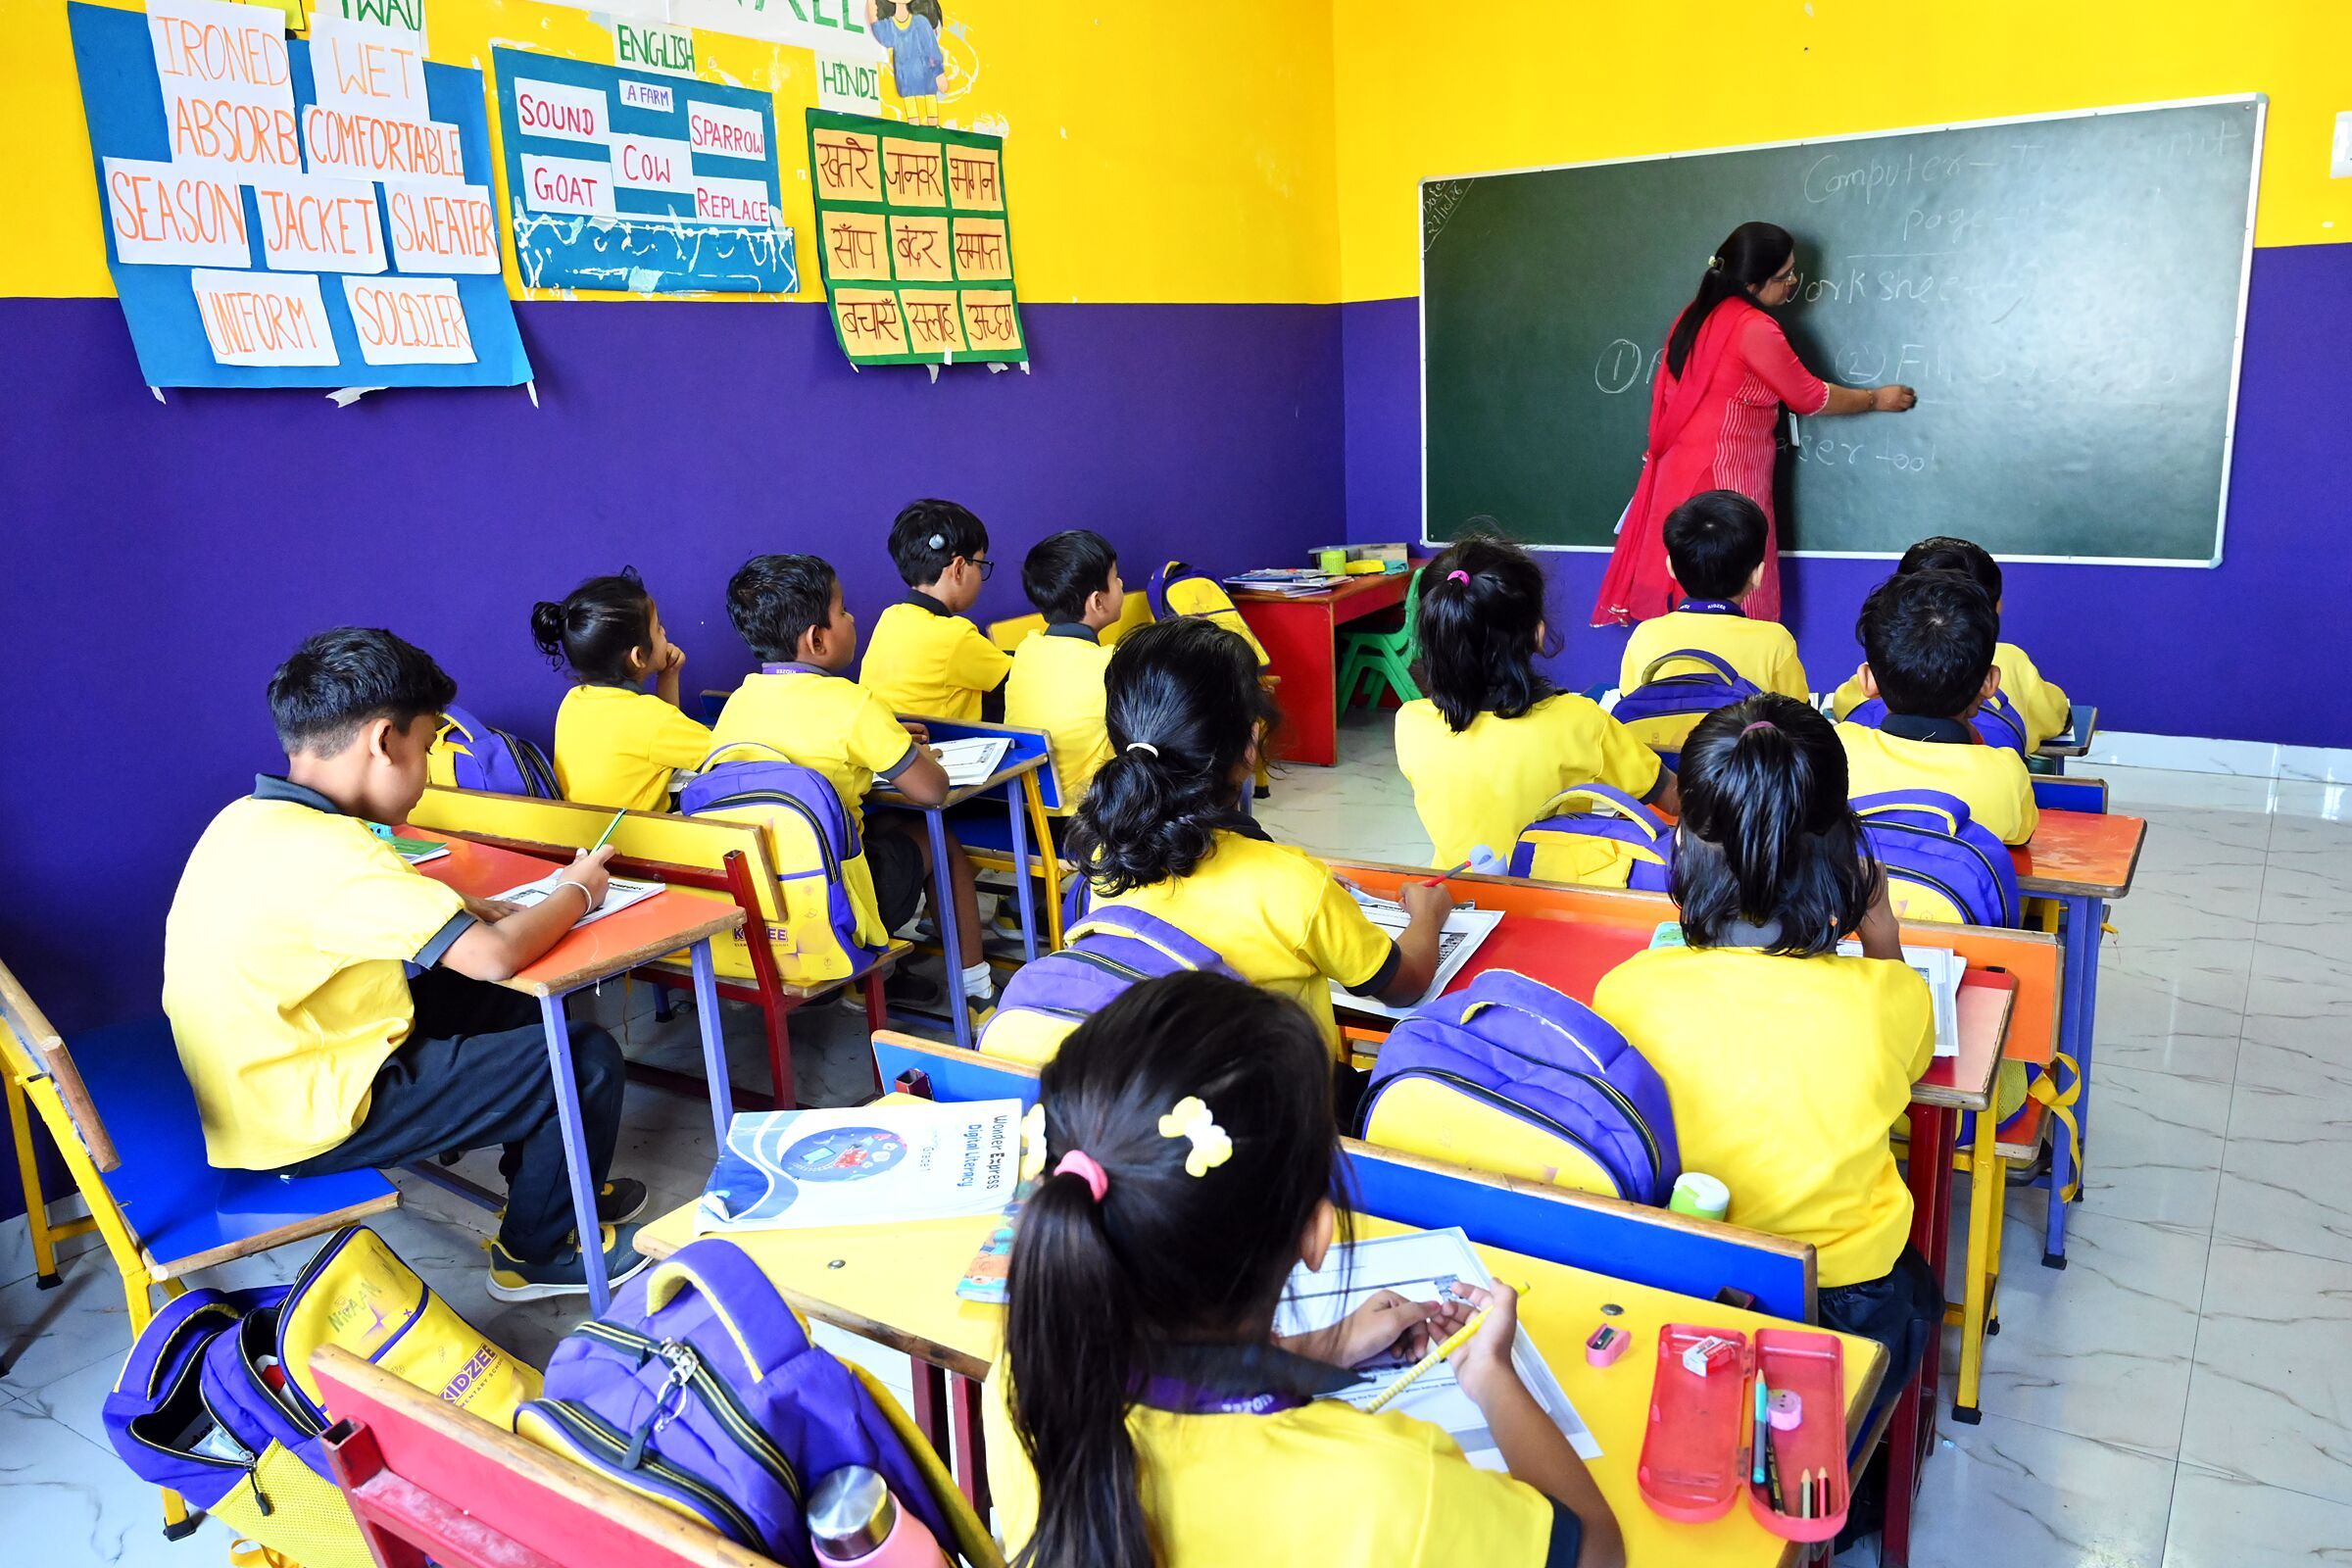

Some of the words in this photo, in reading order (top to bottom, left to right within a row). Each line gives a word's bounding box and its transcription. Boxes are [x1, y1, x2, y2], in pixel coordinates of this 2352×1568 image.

[155, 16, 288, 86] IRONED
[331, 37, 414, 99] WET
[617, 24, 696, 73] ENGLISH
[626, 85, 637, 101] A
[640, 86, 669, 107] FARM
[821, 61, 879, 101] HINDI
[176, 96, 298, 167] ABSORB
[519, 94, 595, 136] SOUND
[691, 115, 764, 154] SPARROW
[309, 108, 465, 177] COMFORTABLE
[816, 137, 875, 189] खतरे
[534, 167, 598, 208] GOAT
[884, 152, 944, 197] जानवर
[112, 172, 247, 245] SEASON
[261, 190, 374, 255] JACKET
[393, 192, 498, 258] SWEATER
[698, 187, 768, 222] REPLACE
[896, 224, 942, 269] बंदर
[195, 290, 318, 356] UNIFORM
[355, 286, 472, 349] SOLDIER
[906, 302, 957, 343] सलाह
[965, 304, 1015, 341] अच्छा
[733, 926, 788, 942] KEE
[962, 1124, 984, 1151] Digital
[991, 1114, 1008, 1151] Wonder
[956, 1152, 981, 1187] Literacy
[986, 1152, 1005, 1190] Express
